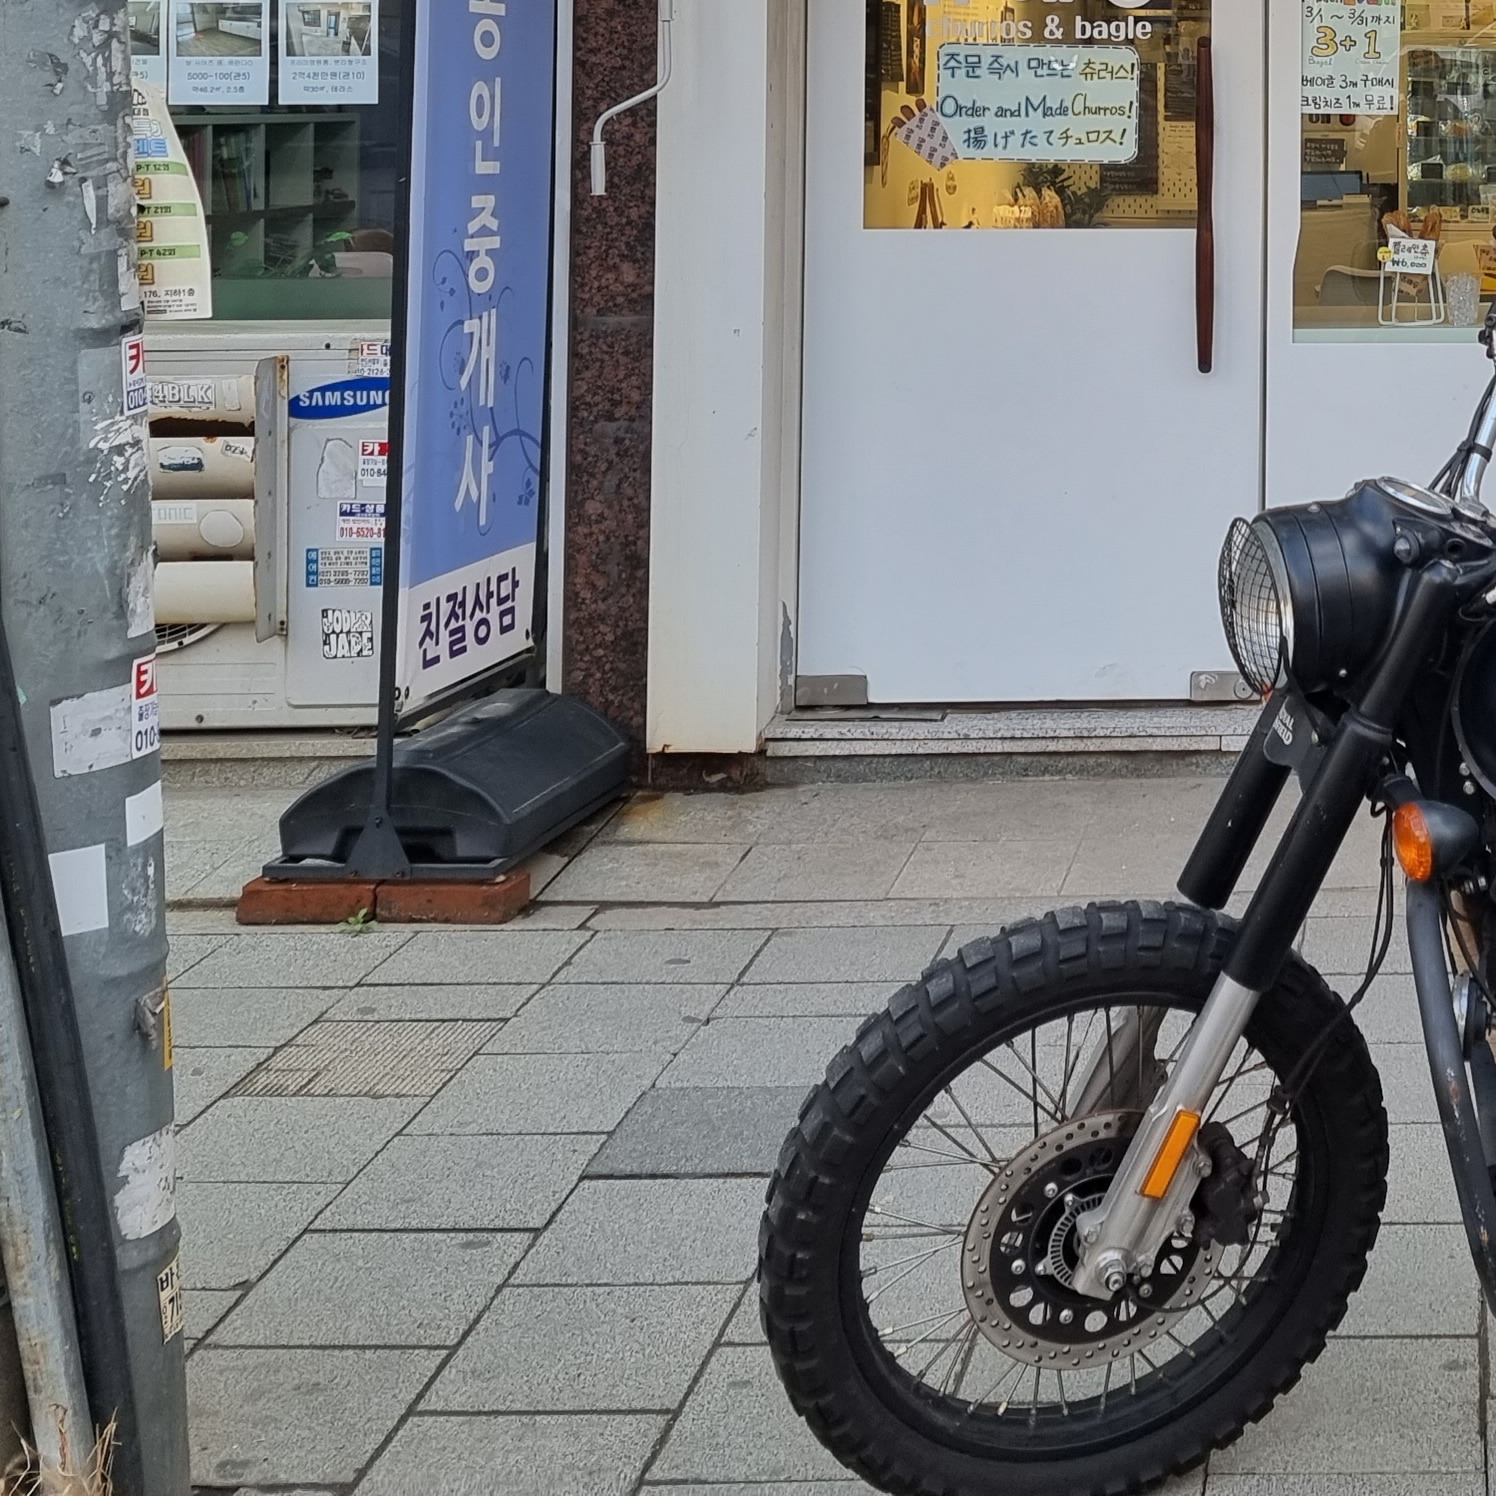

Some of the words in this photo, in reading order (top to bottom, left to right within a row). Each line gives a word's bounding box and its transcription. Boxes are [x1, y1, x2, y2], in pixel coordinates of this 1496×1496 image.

[926, 16, 1032, 40] churros
[1043, 16, 1065, 40] &
[1075, 16, 1152, 41] bagle
[1311, 26, 1381, 59] 3+1
[941, 52, 982, 80] 주문
[986, 52, 1019, 80] 즉시
[1027, 55, 1077, 79] 만드는
[1079, 58, 1136, 82] 츄러스!
[1302, 74, 1336, 89] 베이글
[940, 94, 991, 119] Order
[994, 100, 1022, 119] and
[1025, 95, 1069, 119] Made
[1071, 92, 1134, 119] Churros!
[1301, 95, 1343, 111] 크림치즈
[416, 566, 521, 670] 친절상담
